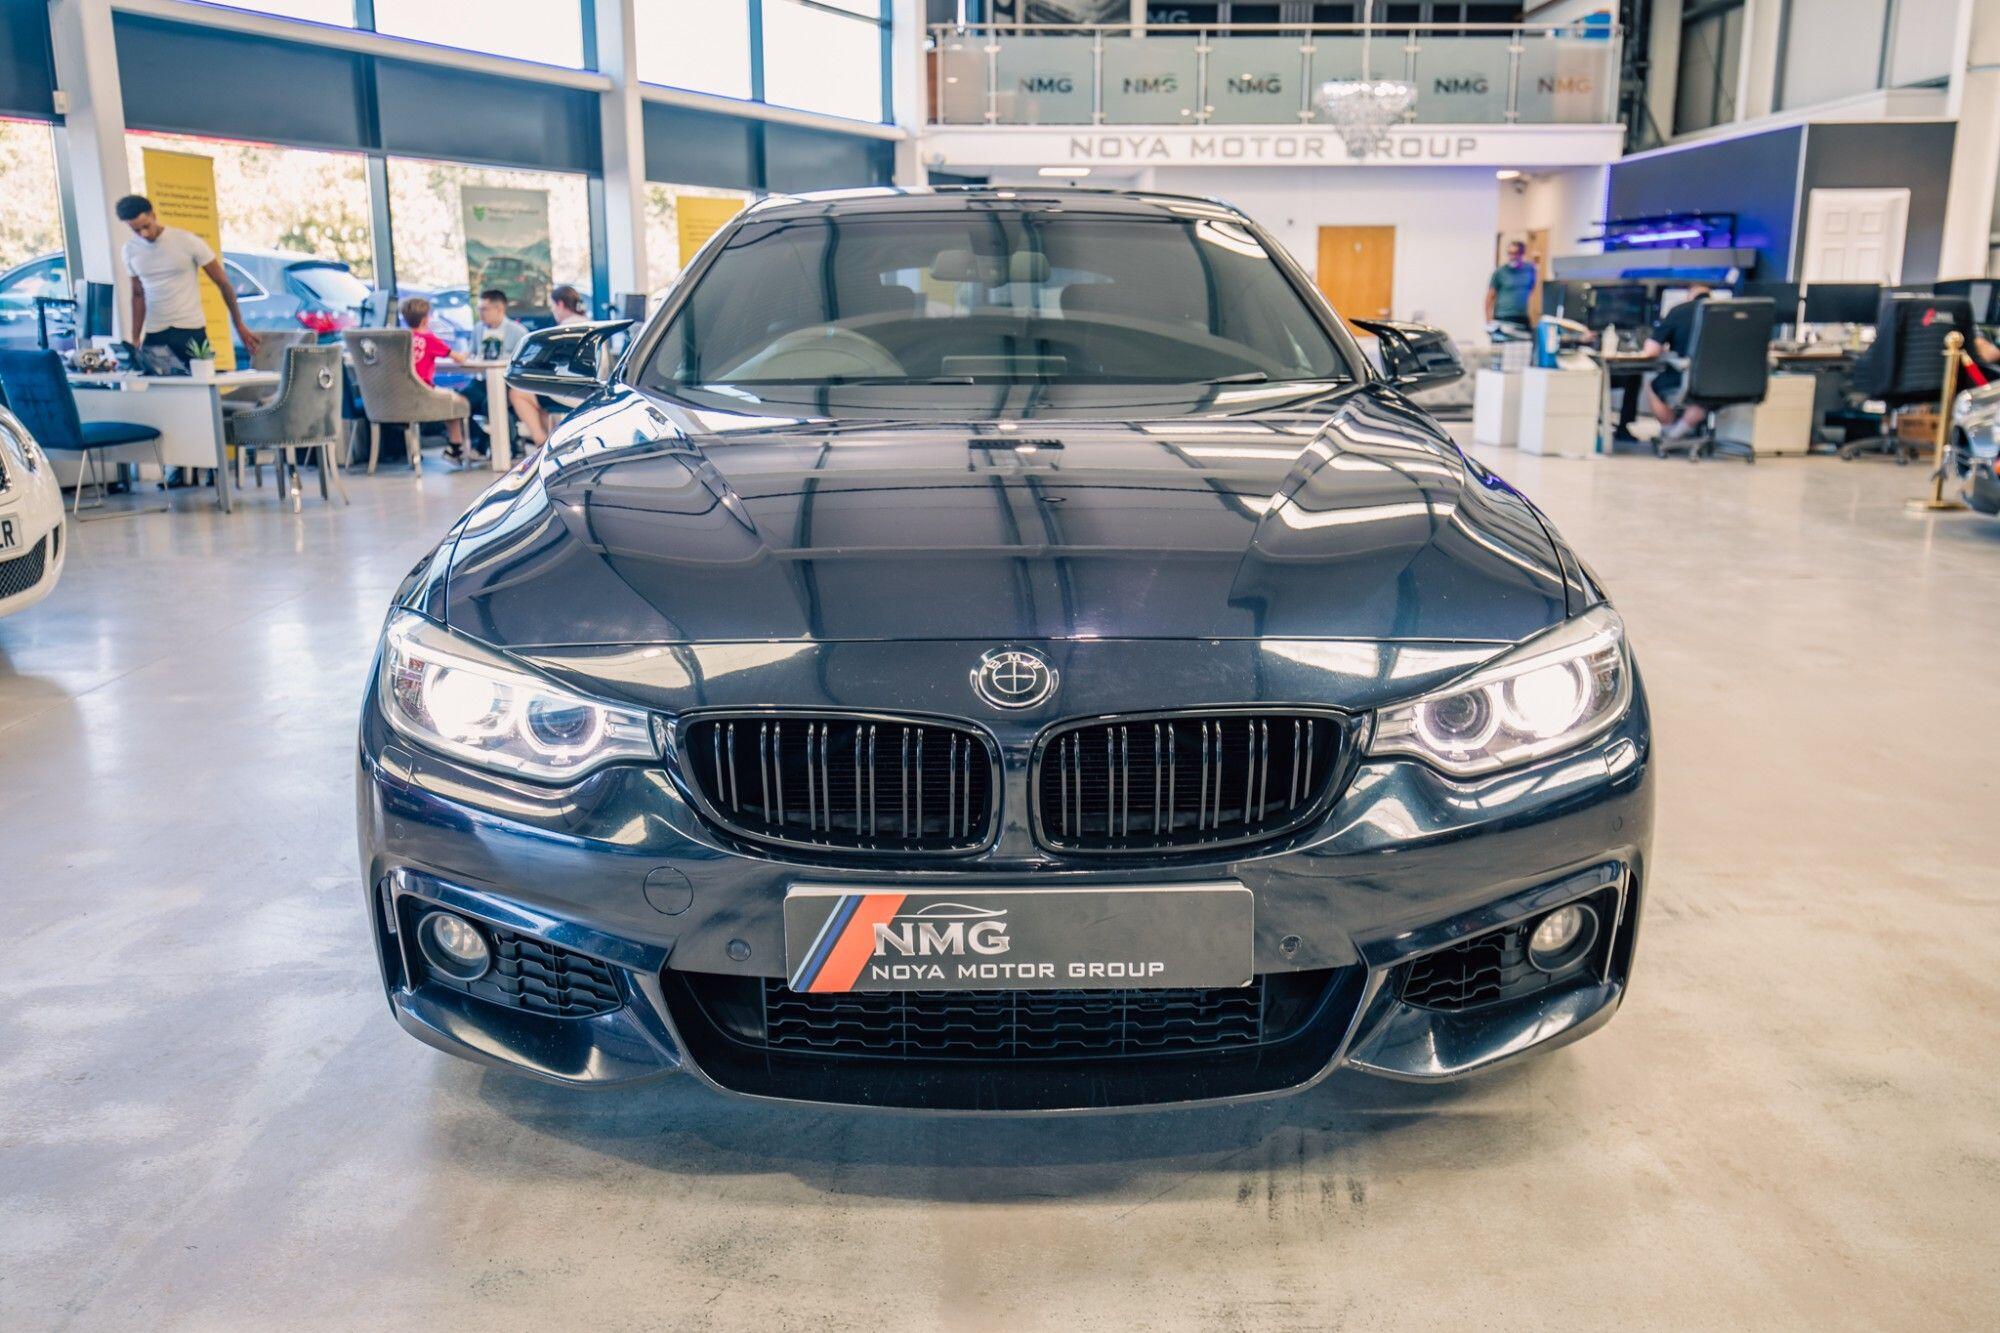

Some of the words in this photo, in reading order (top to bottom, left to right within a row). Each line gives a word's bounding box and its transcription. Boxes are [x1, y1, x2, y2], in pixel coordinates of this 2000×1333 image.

[1020, 77, 1073, 94] NMG
[1123, 77, 1178, 94] NMG
[1228, 78, 1282, 94] NMG
[1434, 77, 1489, 94] NMG
[1537, 77, 1592, 94] NMG
[1069, 136, 1171, 158] NOYA
[1190, 136, 1325, 158] MOTOR
[1346, 137, 1478, 158] ROUP
[0, 519, 15, 548] R
[986, 653, 1044, 669] BMW
[872, 920, 1010, 956] NMG
[872, 964, 945, 980] NOYA
[958, 963, 1056, 979] MOTOR
[1068, 962, 1165, 978] GROUP
